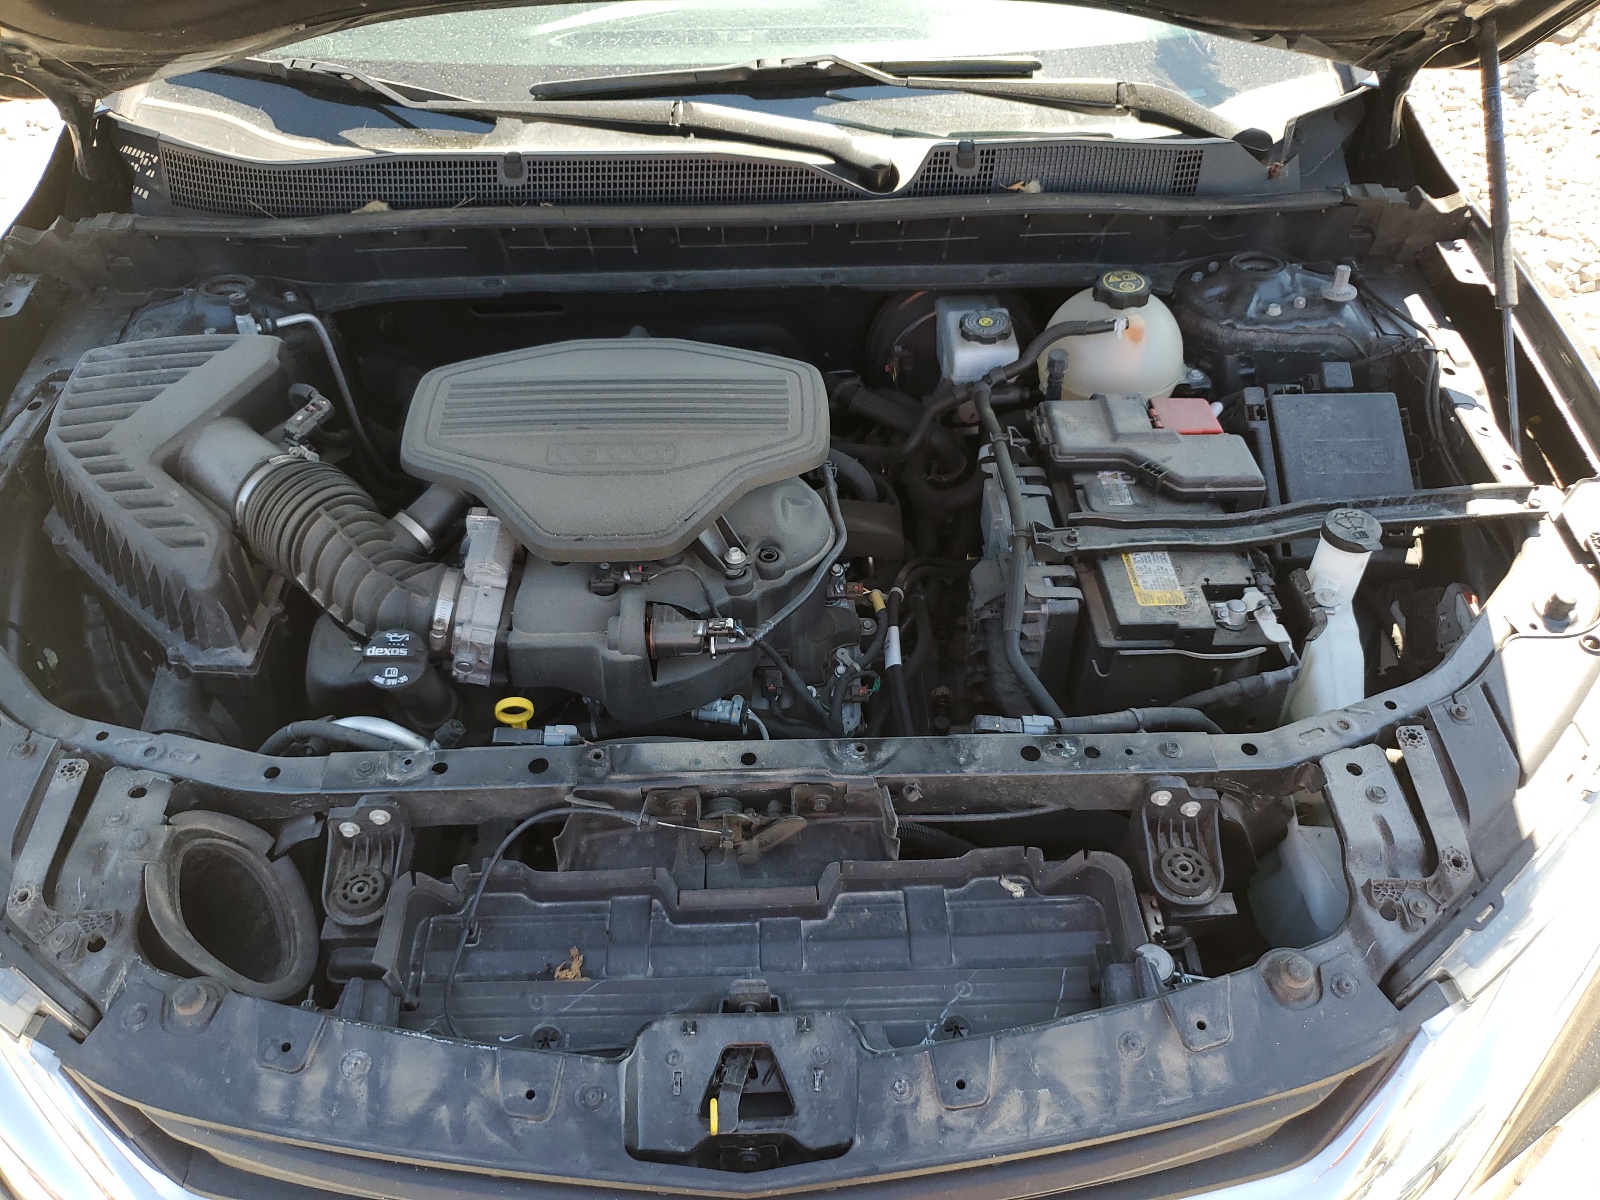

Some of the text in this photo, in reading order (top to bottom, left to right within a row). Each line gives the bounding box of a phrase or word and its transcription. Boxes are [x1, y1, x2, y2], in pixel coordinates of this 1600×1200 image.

[366, 646, 408, 656] dexos
[373, 675, 409, 685] SAE 5W-30
